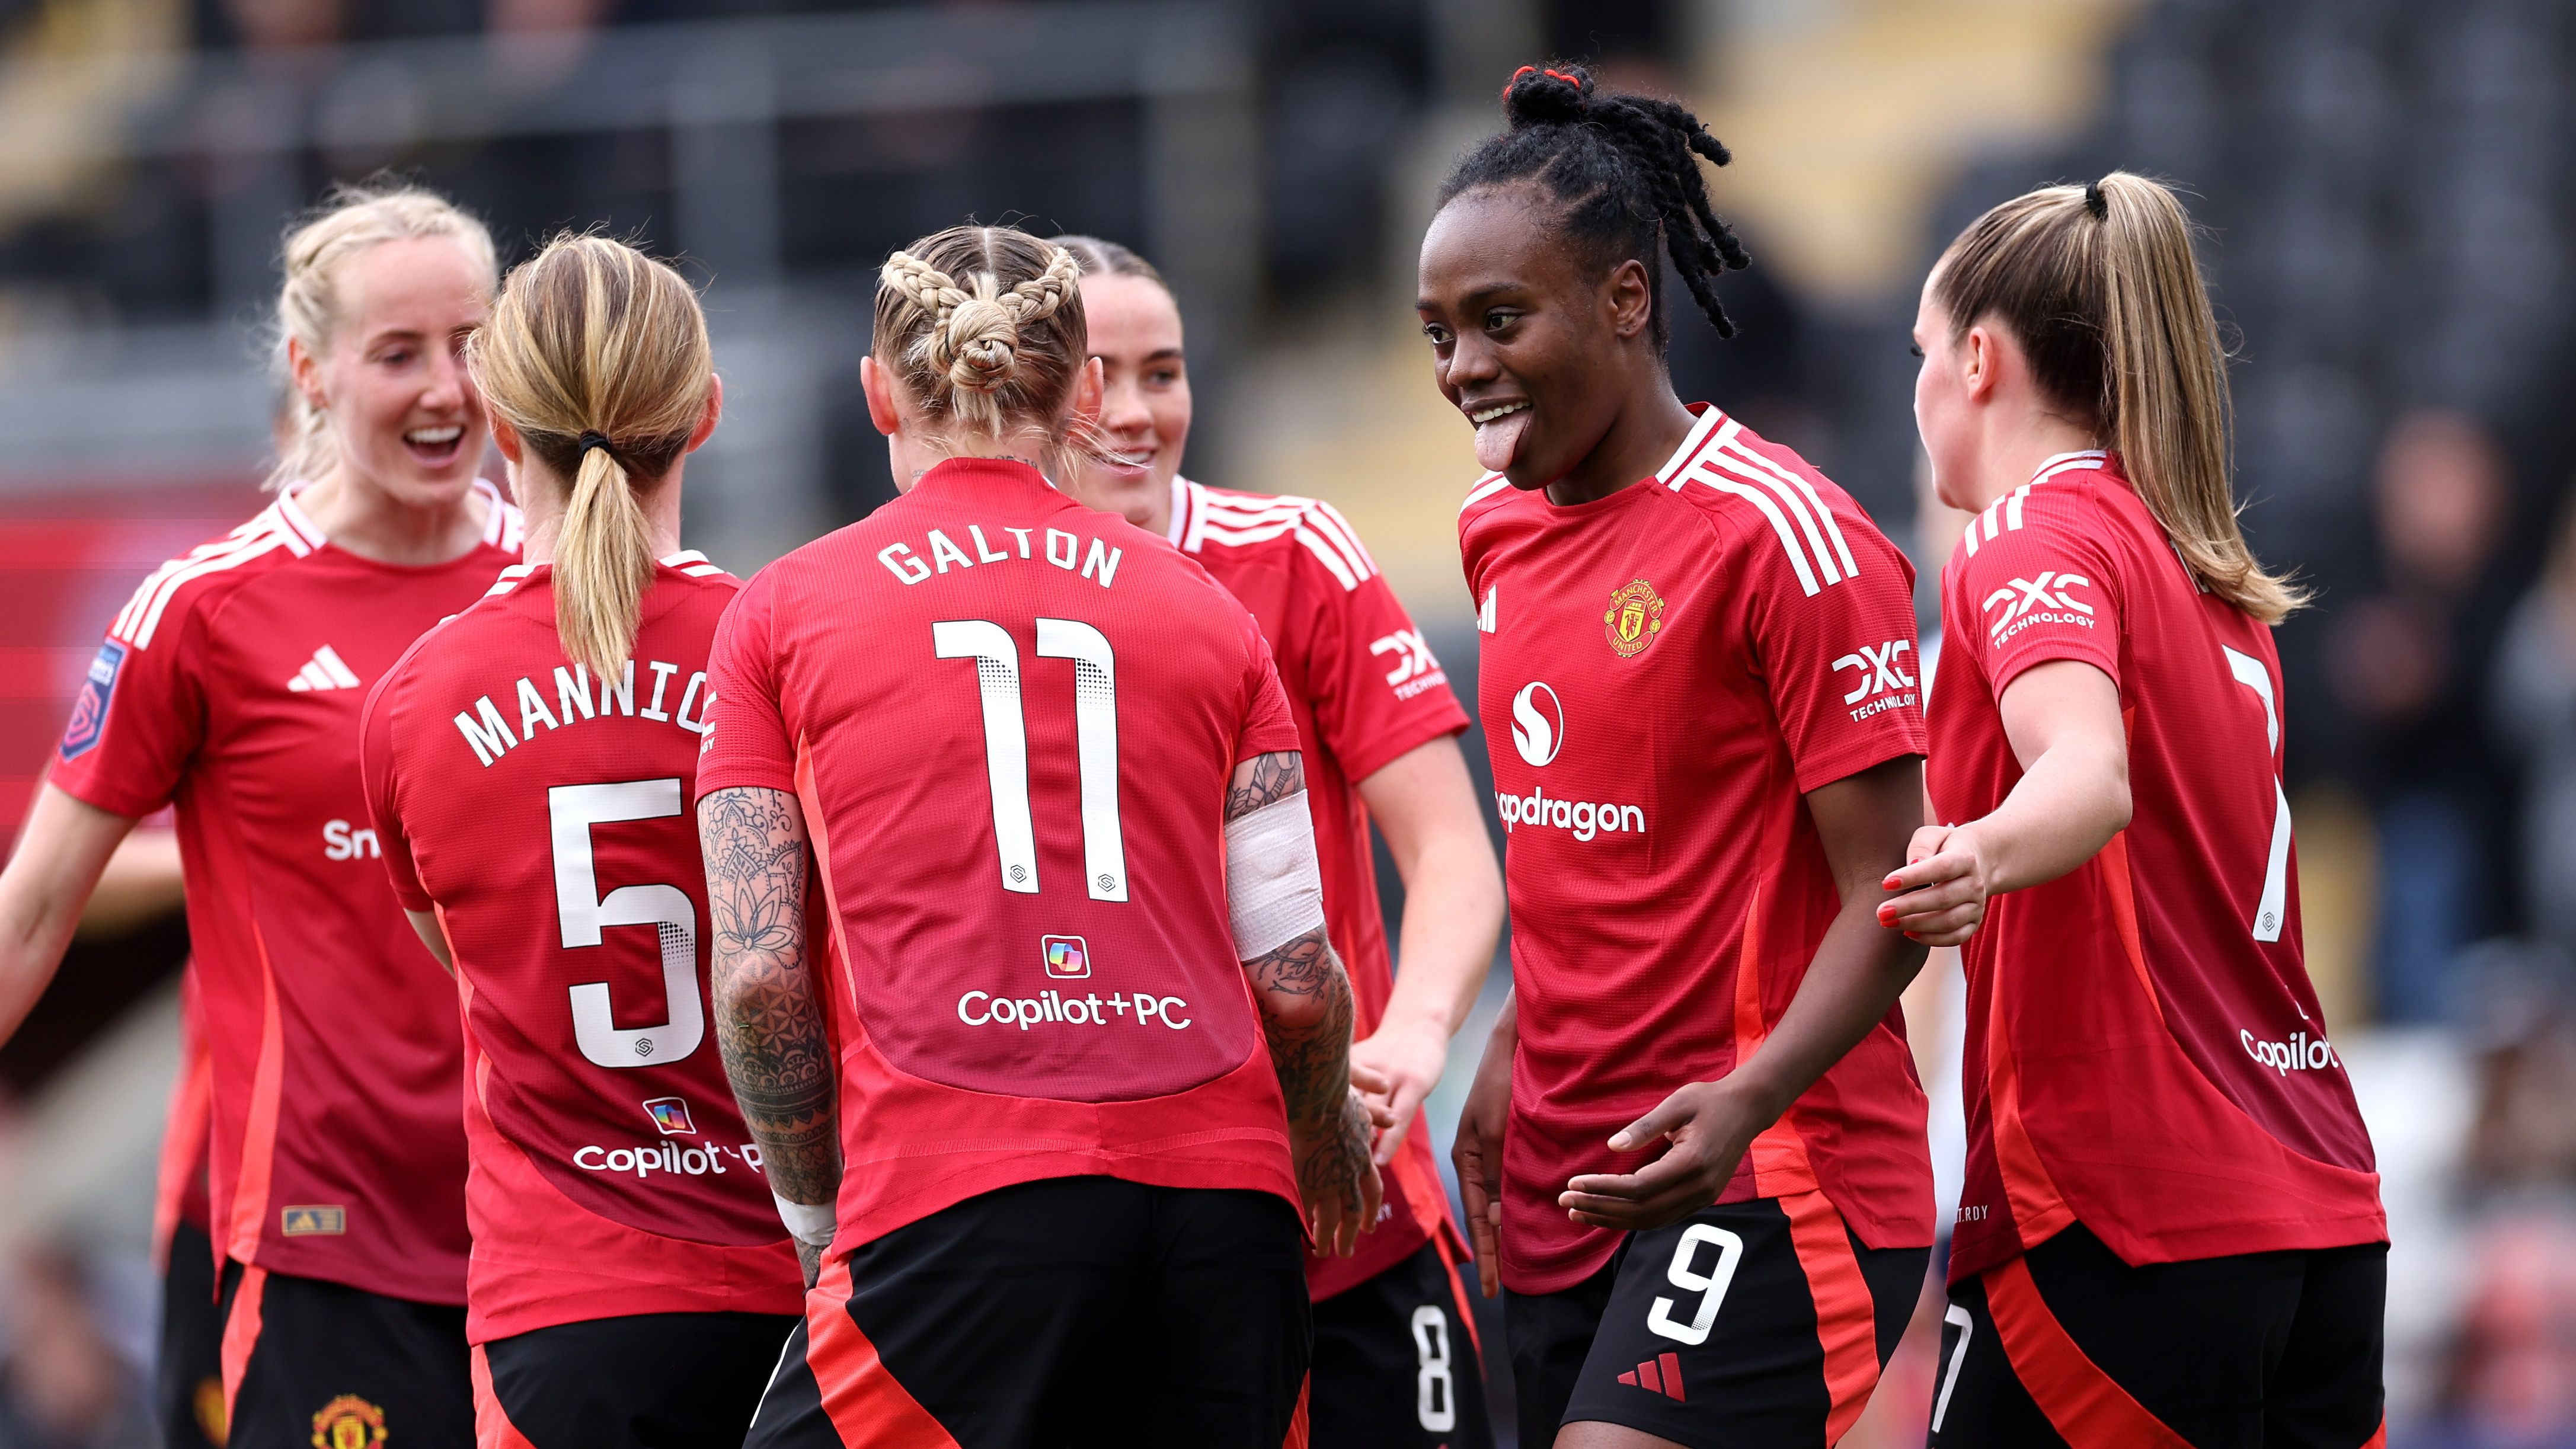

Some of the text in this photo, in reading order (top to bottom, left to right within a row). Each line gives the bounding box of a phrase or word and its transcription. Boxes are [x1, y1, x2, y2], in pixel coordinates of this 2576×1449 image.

[878, 524, 1123, 588] GALTON
[1614, 584, 1658, 613] MANCHESTER
[1613, 636, 1642, 652] UNITED
[1994, 612, 2095, 650] TECHNOLOGY
[931, 618, 1129, 902] 11
[1495, 786, 1645, 842] apdragon
[2221, 644, 2292, 943] 7
[548, 778, 705, 1069] 5
[1647, 1223, 1744, 1346] 9
[1411, 1305, 1455, 1432] 8
[1932, 1303, 1973, 1433] 7
